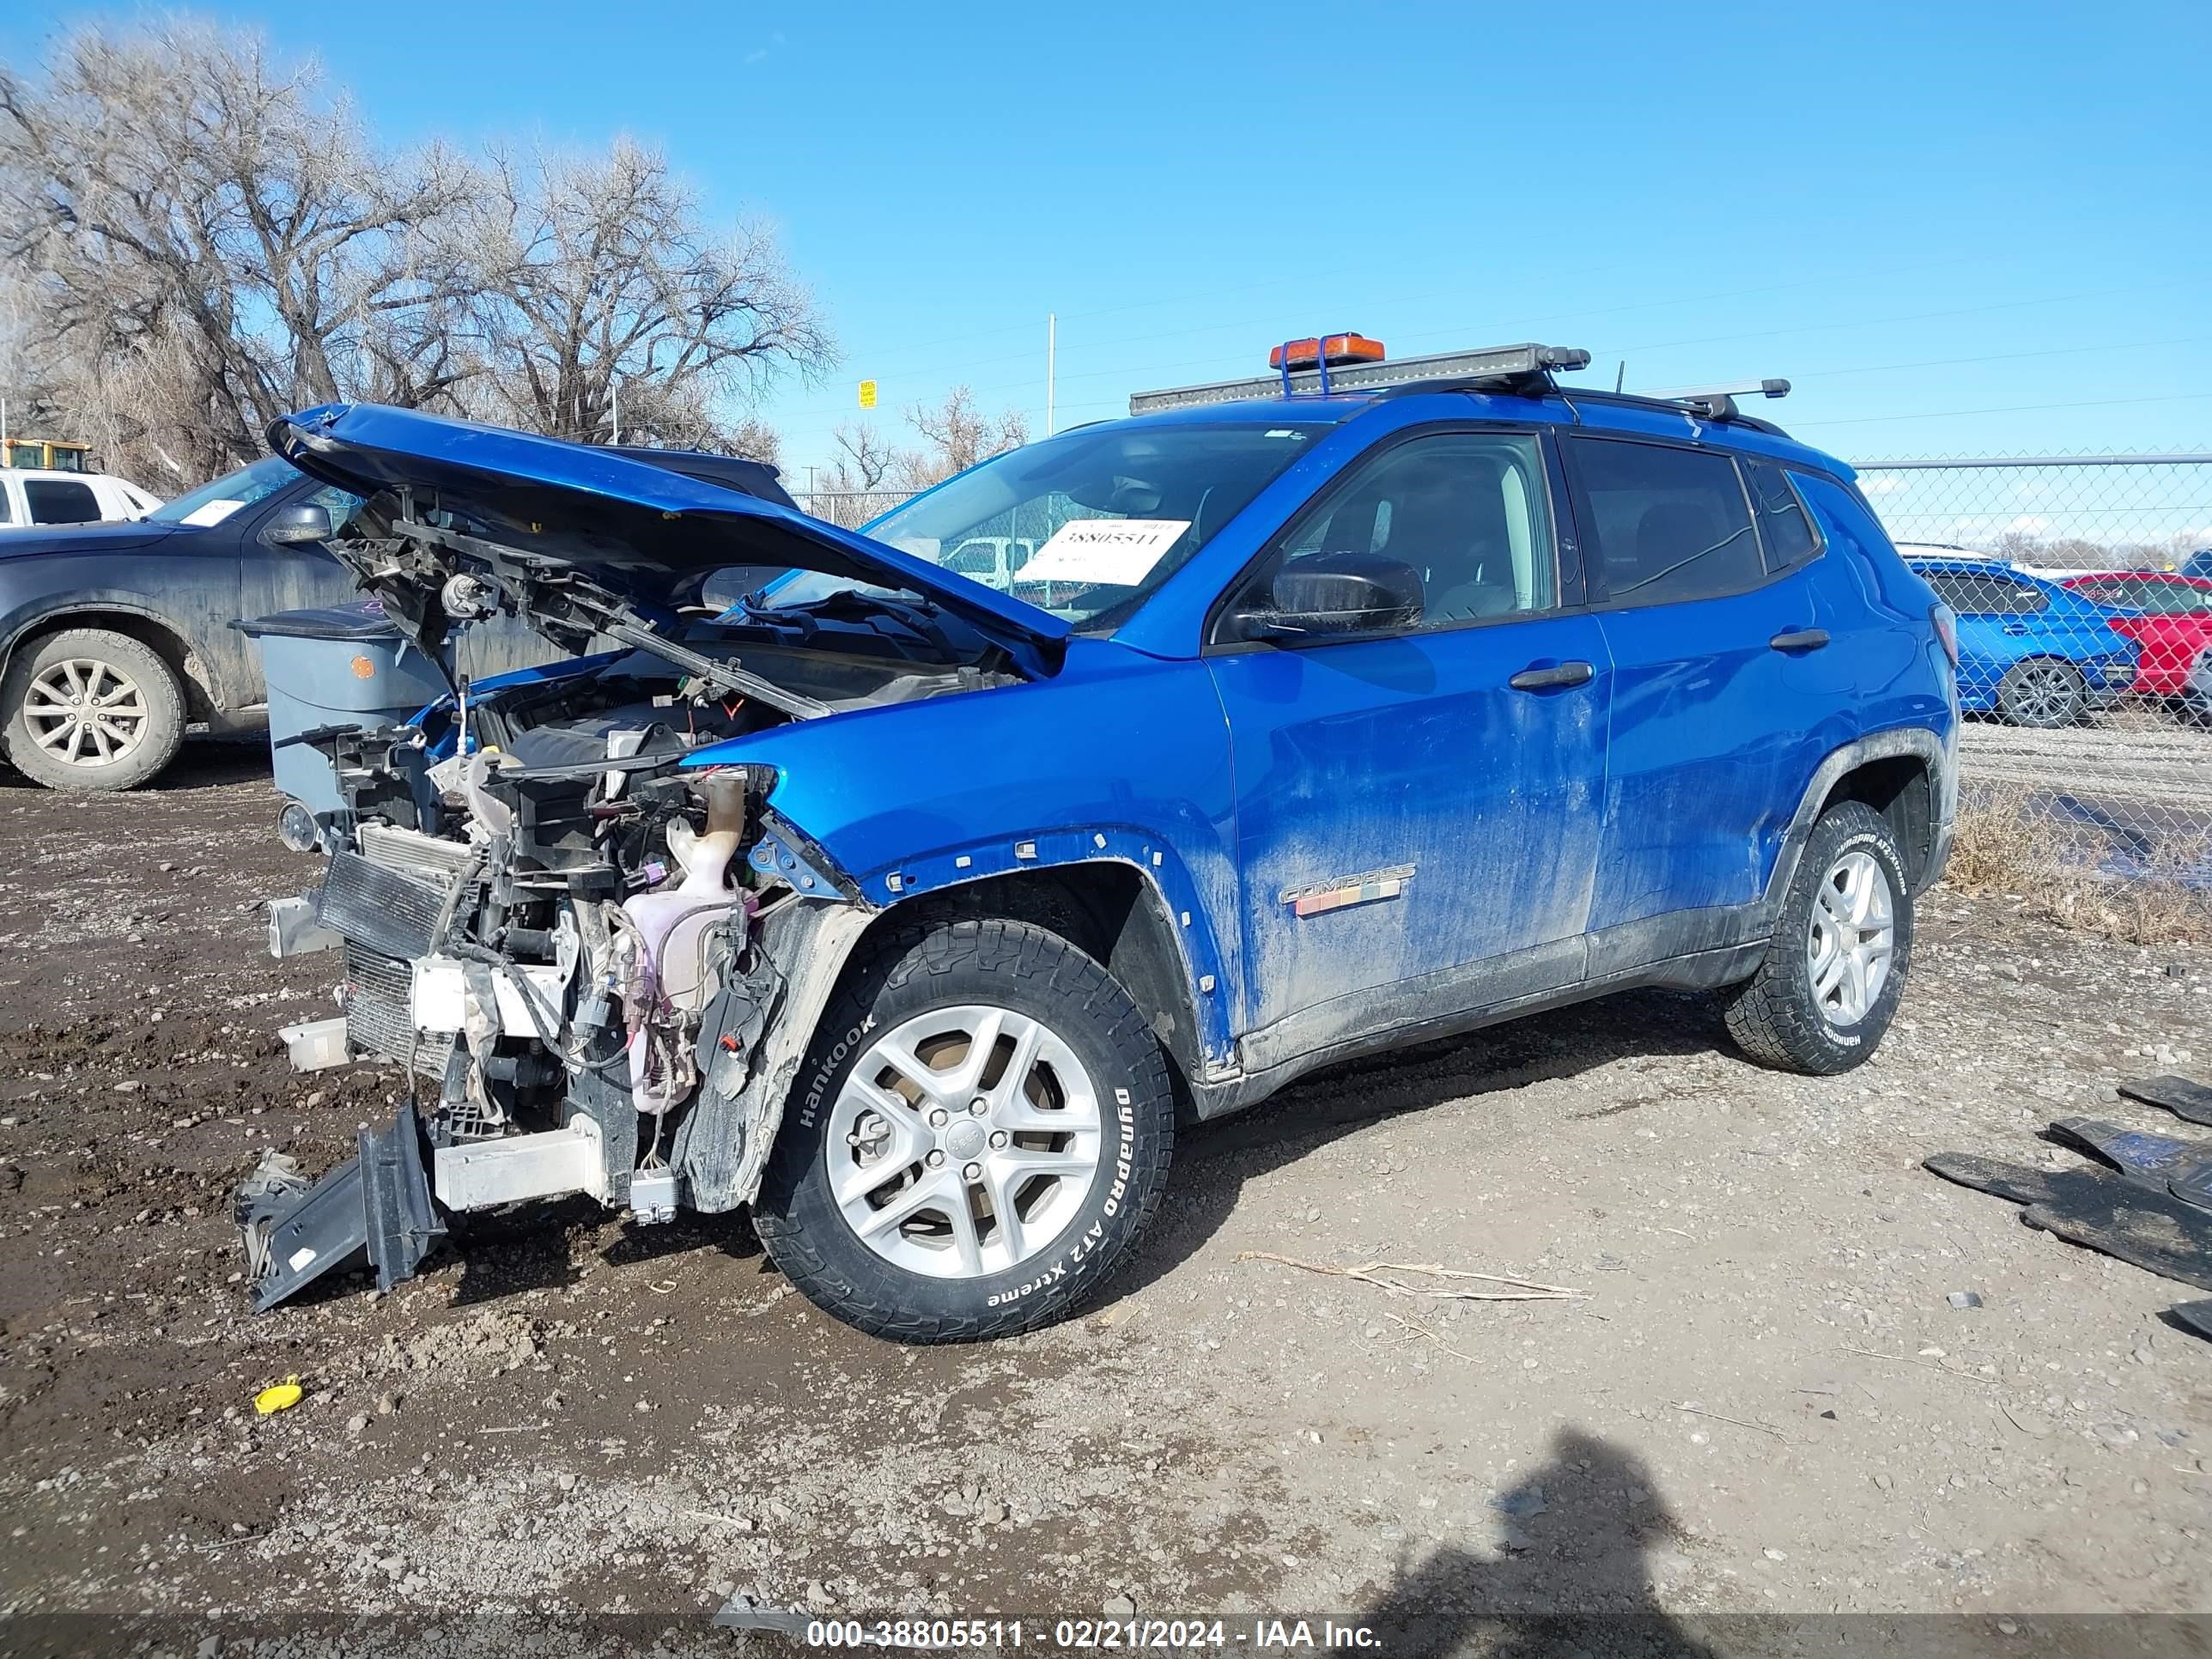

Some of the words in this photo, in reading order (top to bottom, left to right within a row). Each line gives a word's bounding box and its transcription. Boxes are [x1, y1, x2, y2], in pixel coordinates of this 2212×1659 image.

[1279, 863, 1416, 905] COMPASS
[1069, 1218, 1103, 1263] AT2
[988, 1260, 1067, 1308] Xtreme
